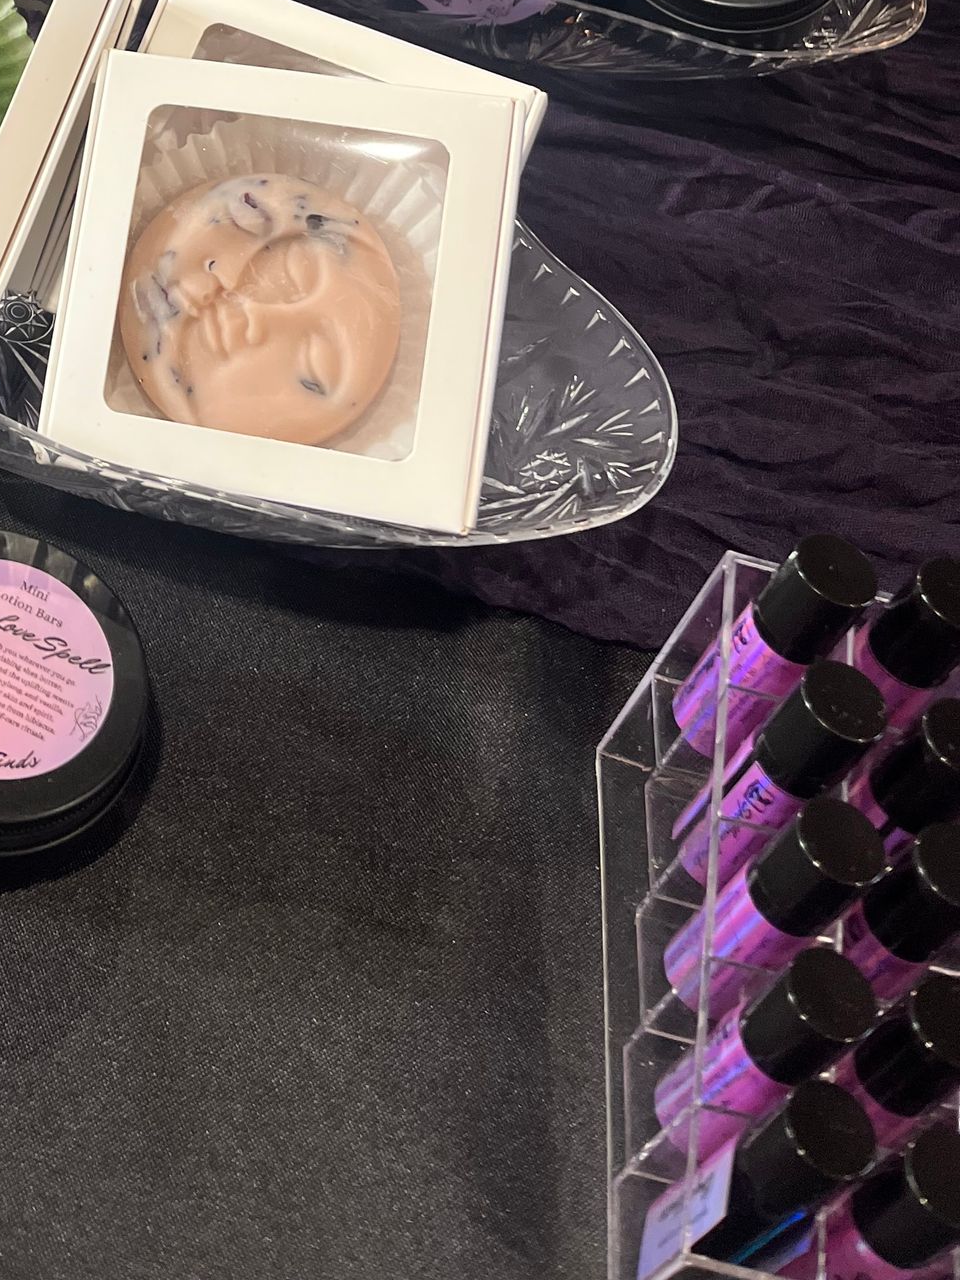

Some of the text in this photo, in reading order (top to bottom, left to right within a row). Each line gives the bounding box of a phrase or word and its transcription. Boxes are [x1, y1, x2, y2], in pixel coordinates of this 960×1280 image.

[20, 580, 51, 603] Mini
[34, 606, 65, 629] Bars
[33, 636, 112, 675] Spell
